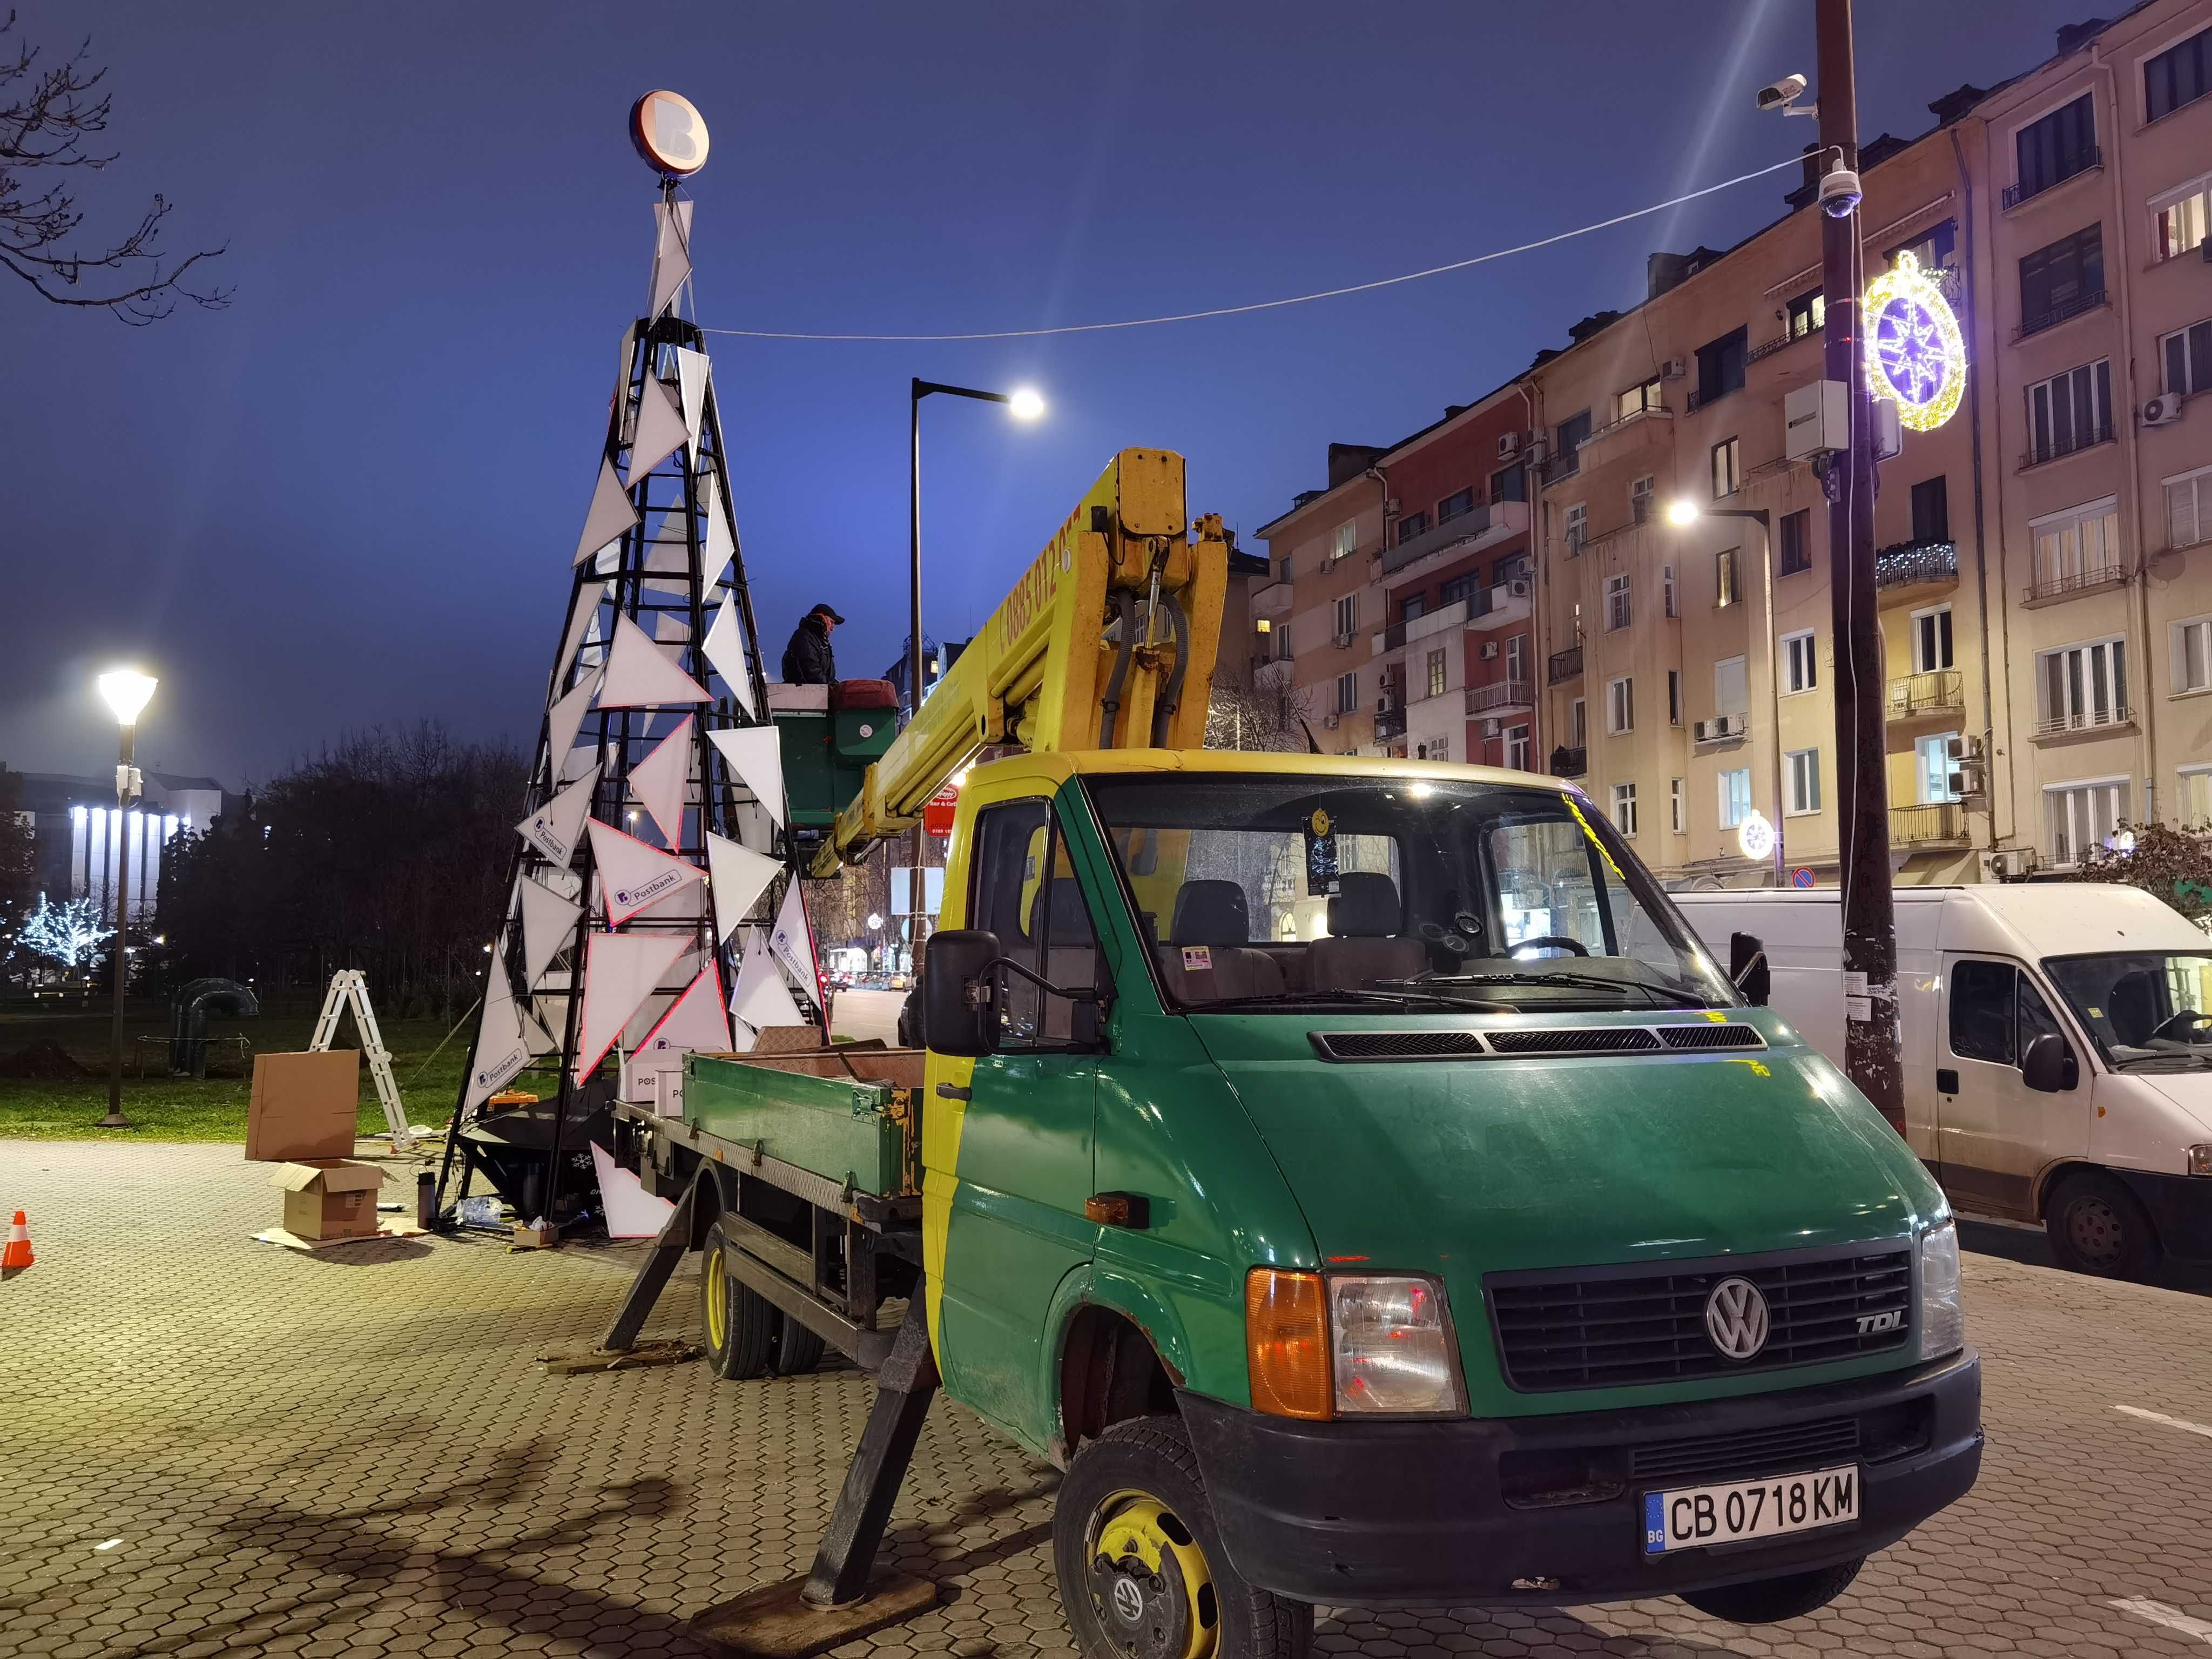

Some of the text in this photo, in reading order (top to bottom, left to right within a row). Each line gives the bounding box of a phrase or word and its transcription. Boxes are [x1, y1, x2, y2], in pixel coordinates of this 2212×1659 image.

[1007, 570, 1032, 646] 0885
[541, 831, 563, 856] Postbank
[633, 874, 676, 900] Postbank
[783, 947, 808, 981] Postbank
[489, 1054, 518, 1082] Postbank
[1856, 1310, 1901, 1333] TDI
[1648, 1529, 1663, 1543] BG
